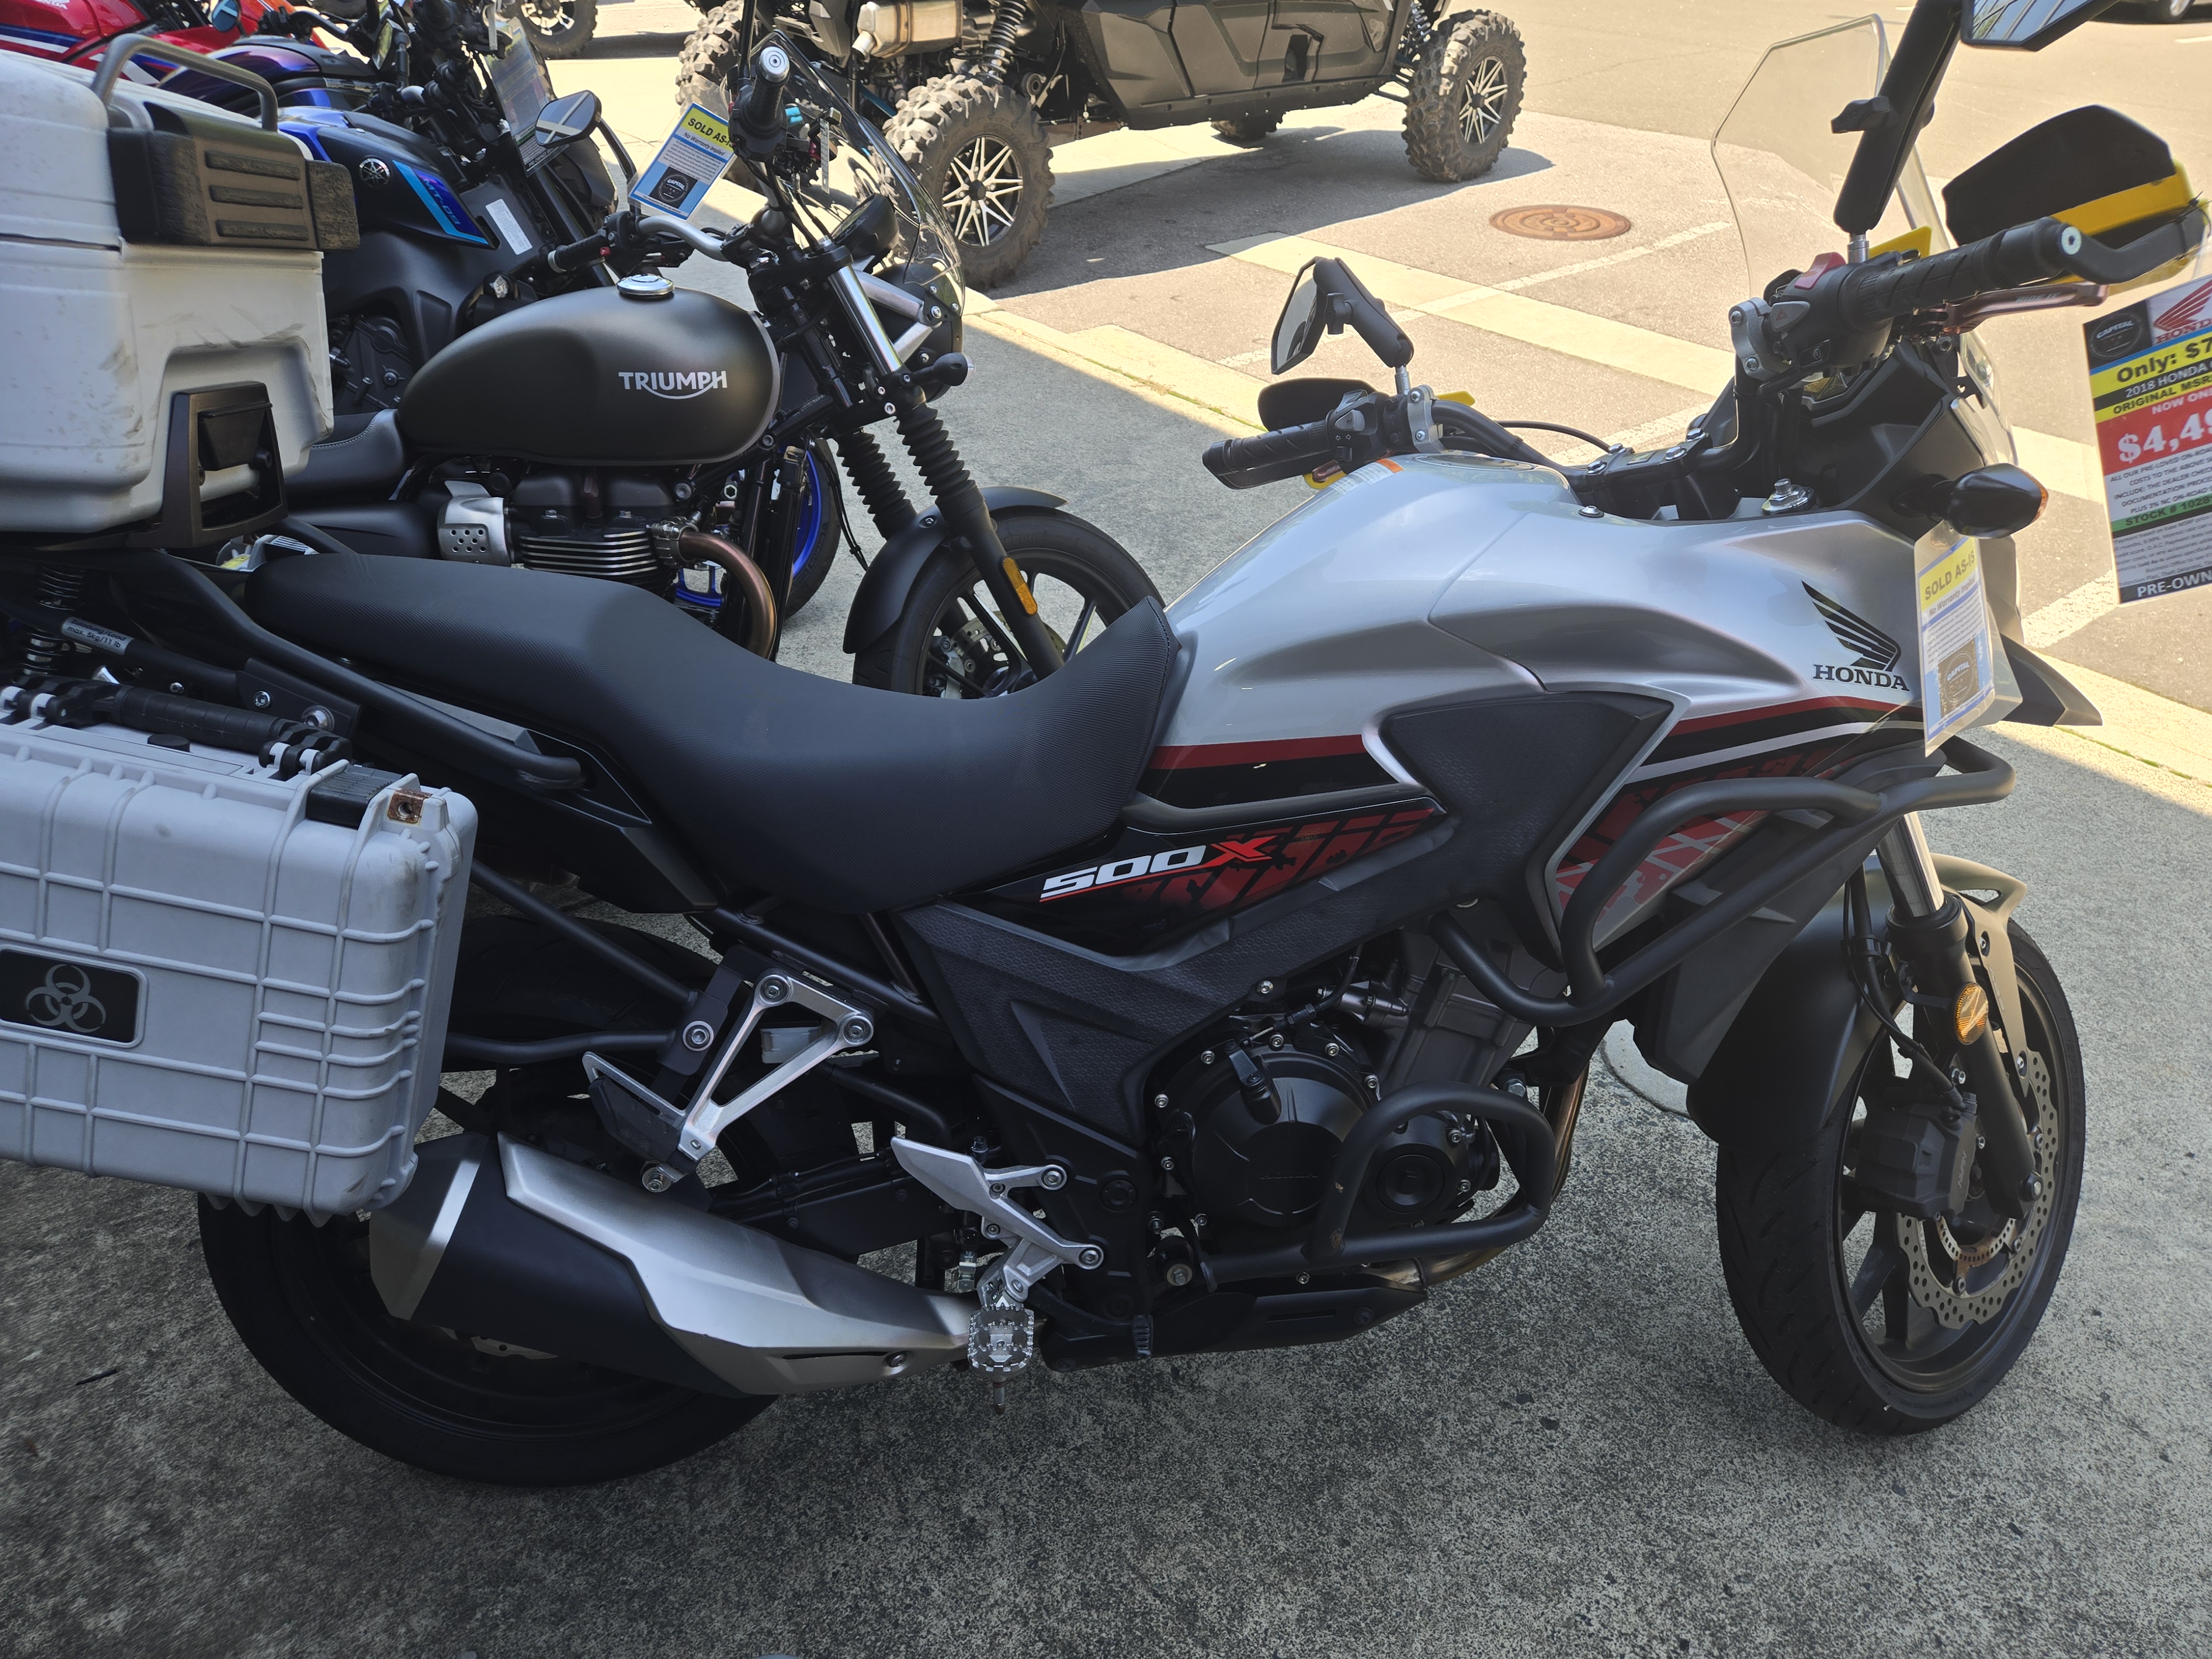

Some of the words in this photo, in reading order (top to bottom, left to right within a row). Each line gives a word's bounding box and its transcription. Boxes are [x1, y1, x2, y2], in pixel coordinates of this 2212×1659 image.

[688, 118, 713, 136] SOLD
[691, 135, 711, 149] Warranty
[423, 178, 461, 225] MT-09
[2096, 320, 2135, 339] CAPITAL
[2117, 353, 2177, 383] Only:
[618, 371, 727, 395] TRIUMPH
[2126, 380, 2156, 398] 2018
[2158, 363, 2208, 386] HONDA
[2113, 388, 2177, 414] ORIGINAL
[2152, 397, 2184, 414] NOW
[2129, 476, 2151, 486] COSTS
[2179, 459, 2206, 470] ABOVE
[2140, 457, 2179, 472] PRE-LOVED
[2114, 487, 2146, 499] INCLUDE:
[2162, 474, 2189, 485] DEALER
[2121, 484, 2185, 507] DOCUMENTATION
[2125, 509, 2166, 526] STOCK
[2180, 495, 2212, 510] 1028
[2130, 505, 2147, 514] PLUS
[1925, 571, 1952, 601] SOLD
[1955, 550, 1975, 579] AS-IS
[1929, 607, 1936, 617] No
[1937, 589, 1960, 611] Warranty
[67, 627, 86, 636] max.
[70, 620, 127, 641] Zuladung/Load
[1813, 664, 1910, 691] HONDA
[1947, 661, 1970, 681] CAPITAL
[1040, 835, 1277, 900] 500X
